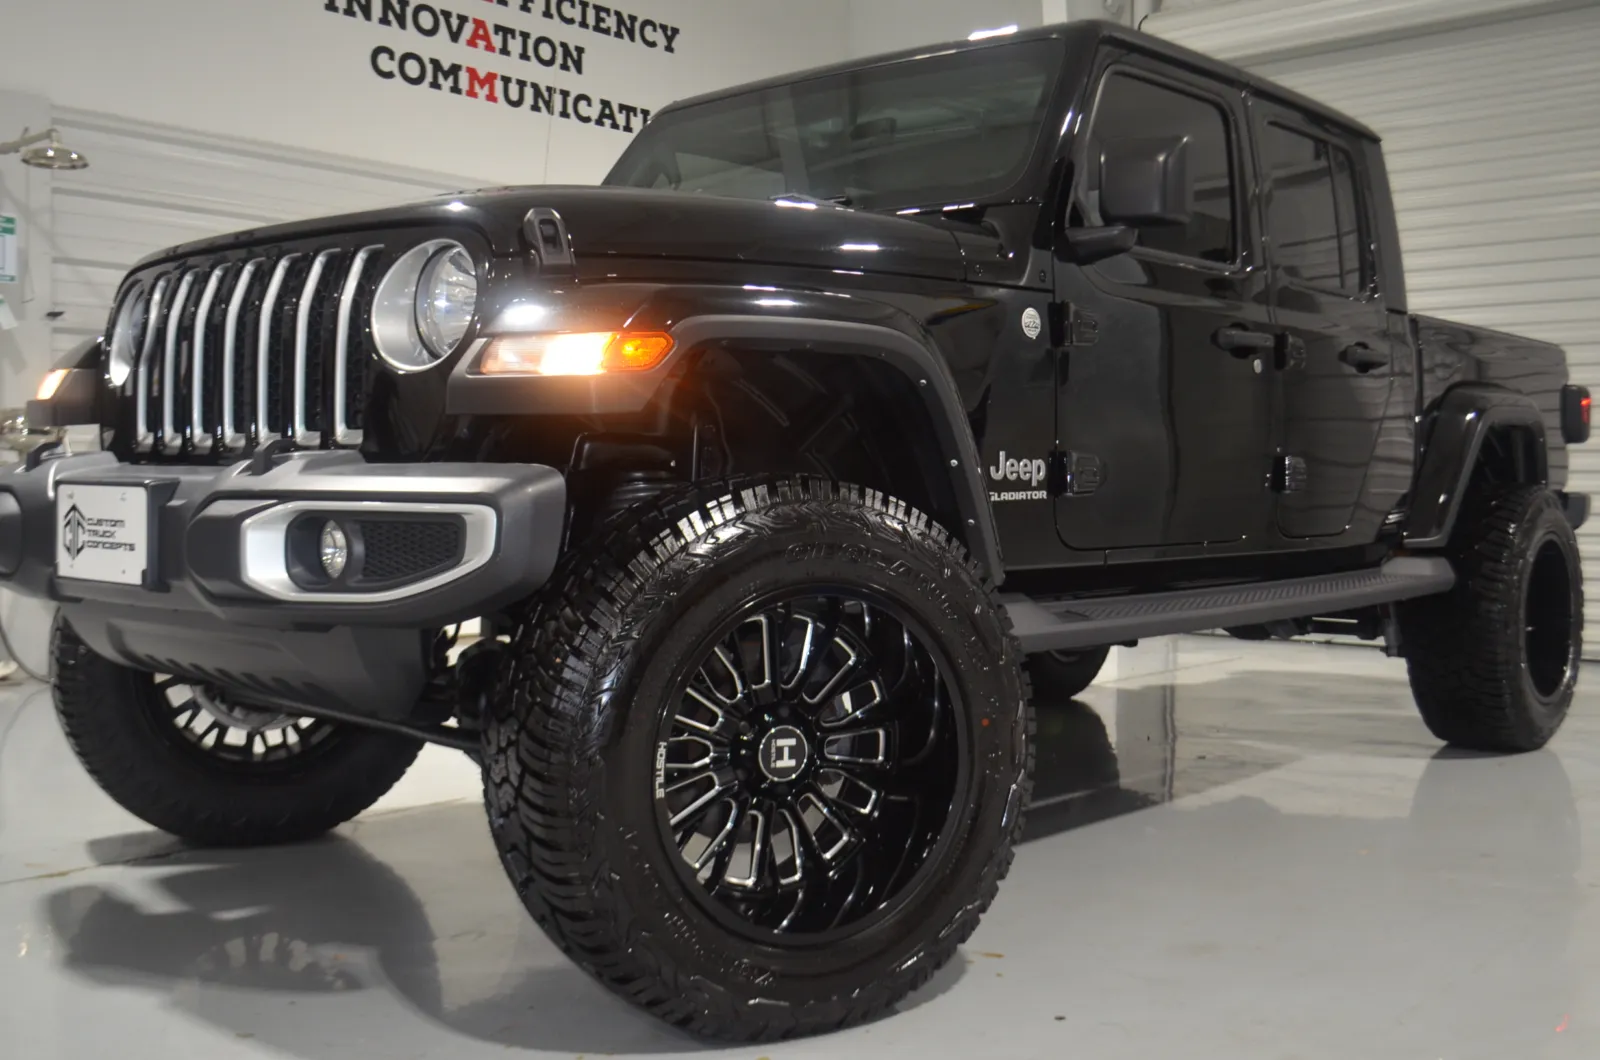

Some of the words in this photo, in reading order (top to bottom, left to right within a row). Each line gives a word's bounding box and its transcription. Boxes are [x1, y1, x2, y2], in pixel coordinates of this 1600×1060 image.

[482, 0, 680, 54] ICIENCY
[989, 450, 1046, 487] Jeep
[86, 529, 117, 539] TRUCK
[87, 517, 126, 528] CUSTOM
[86, 540, 136, 552] CONCEPTS
[655, 741, 668, 800] HOSTILE
